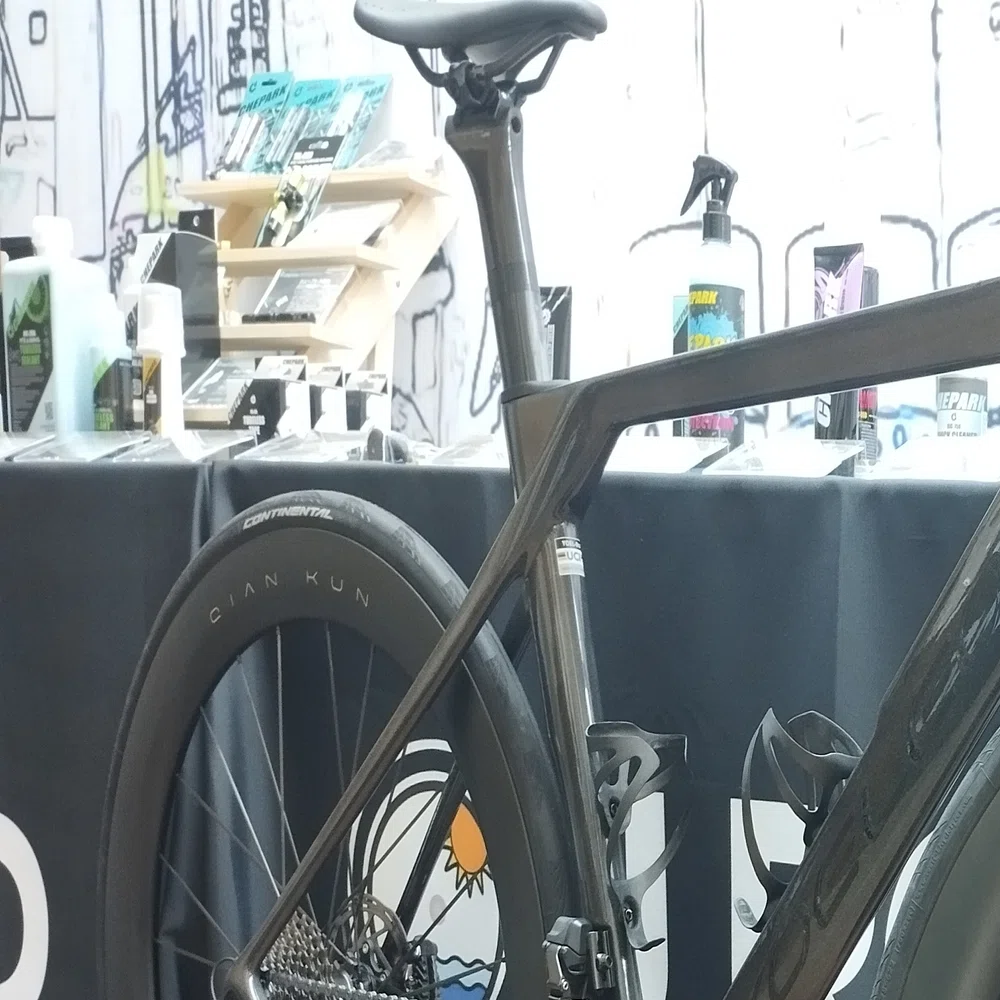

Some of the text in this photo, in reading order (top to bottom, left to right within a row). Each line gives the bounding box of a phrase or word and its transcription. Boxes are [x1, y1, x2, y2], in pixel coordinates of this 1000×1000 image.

[238, 83, 288, 117] CHEPARK
[689, 290, 719, 305] PARK
[242, 505, 334, 530] CONTINENTAL
[306, 570, 370, 608] KUN
